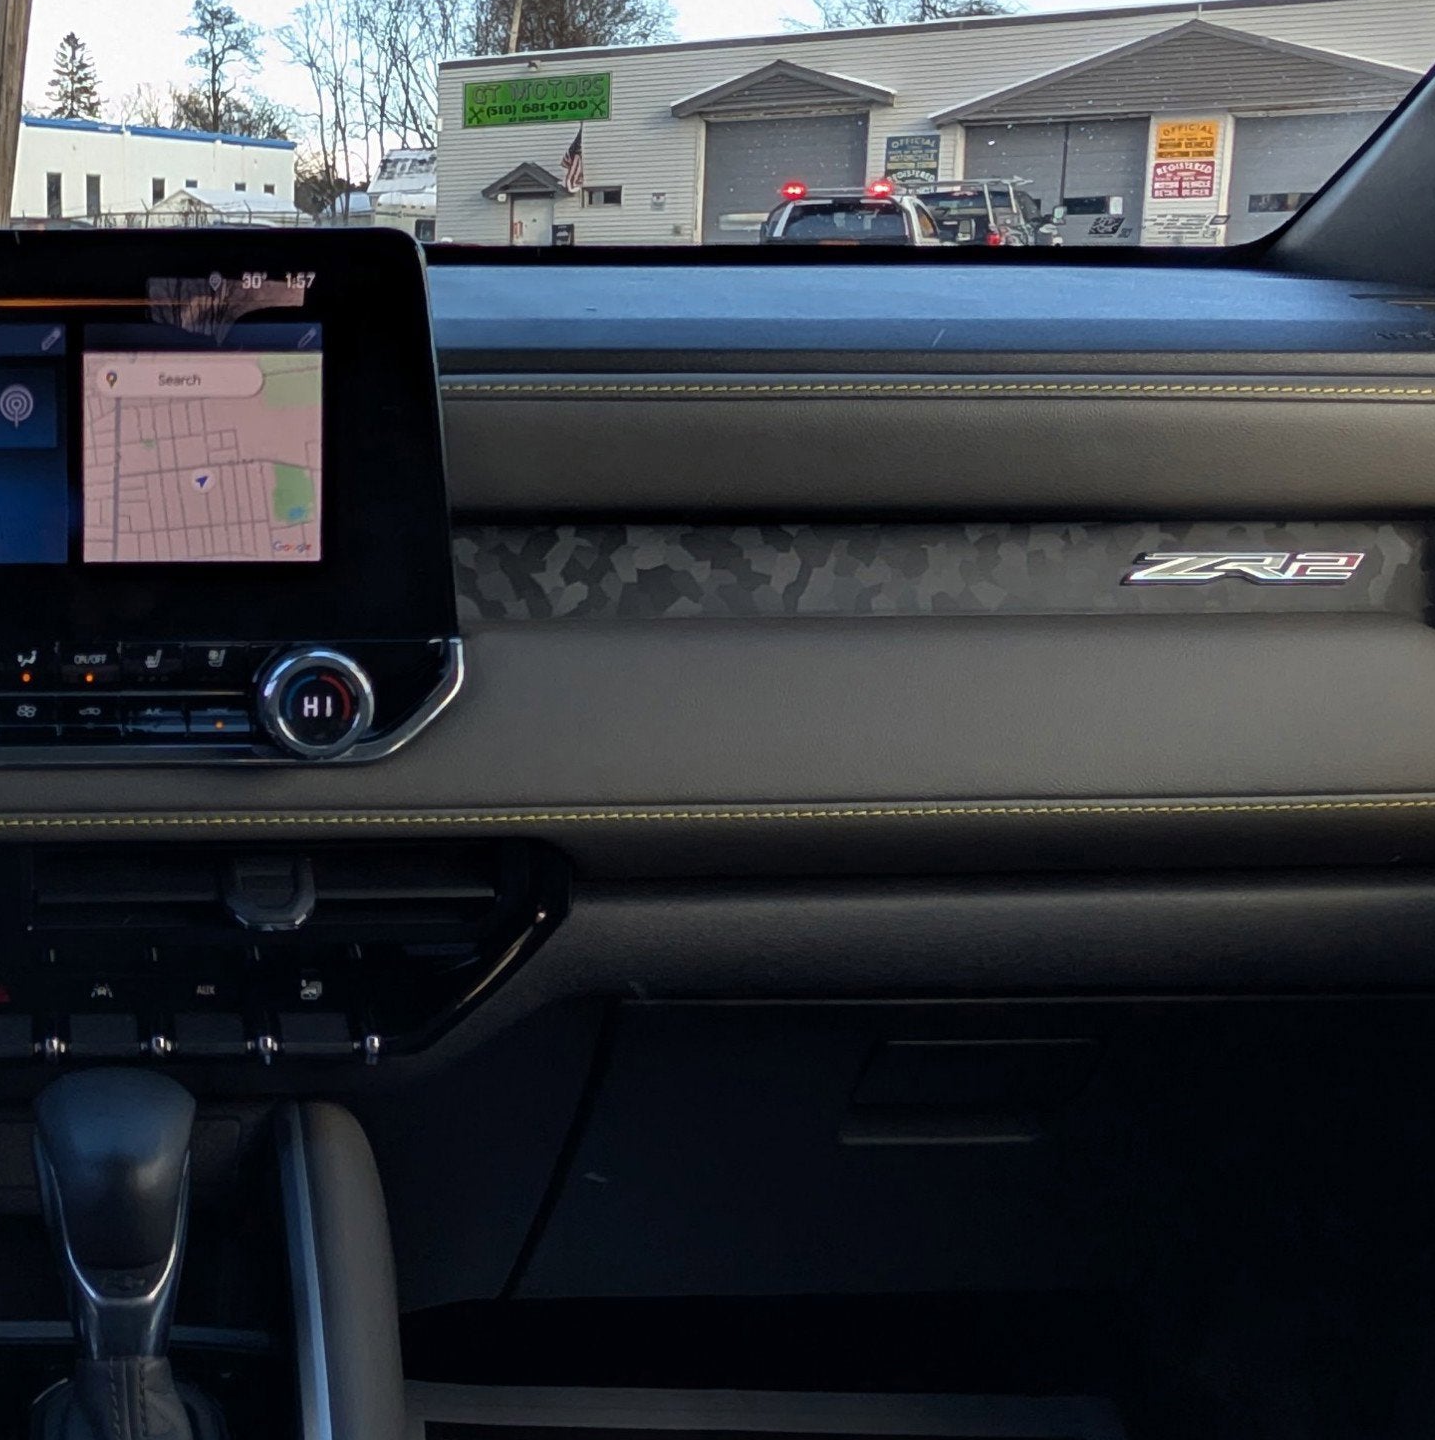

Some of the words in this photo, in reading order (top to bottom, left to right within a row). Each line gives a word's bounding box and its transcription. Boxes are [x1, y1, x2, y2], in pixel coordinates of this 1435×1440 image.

[508, 77, 605, 102] MOTORS
[285, 271, 316, 289] 1:57
[158, 372, 201, 387] Search
[273, 540, 312, 553] Google
[1120, 551, 1365, 585] ZR2
[73, 654, 107, 665] ON/OFF
[303, 695, 331, 718] HI
